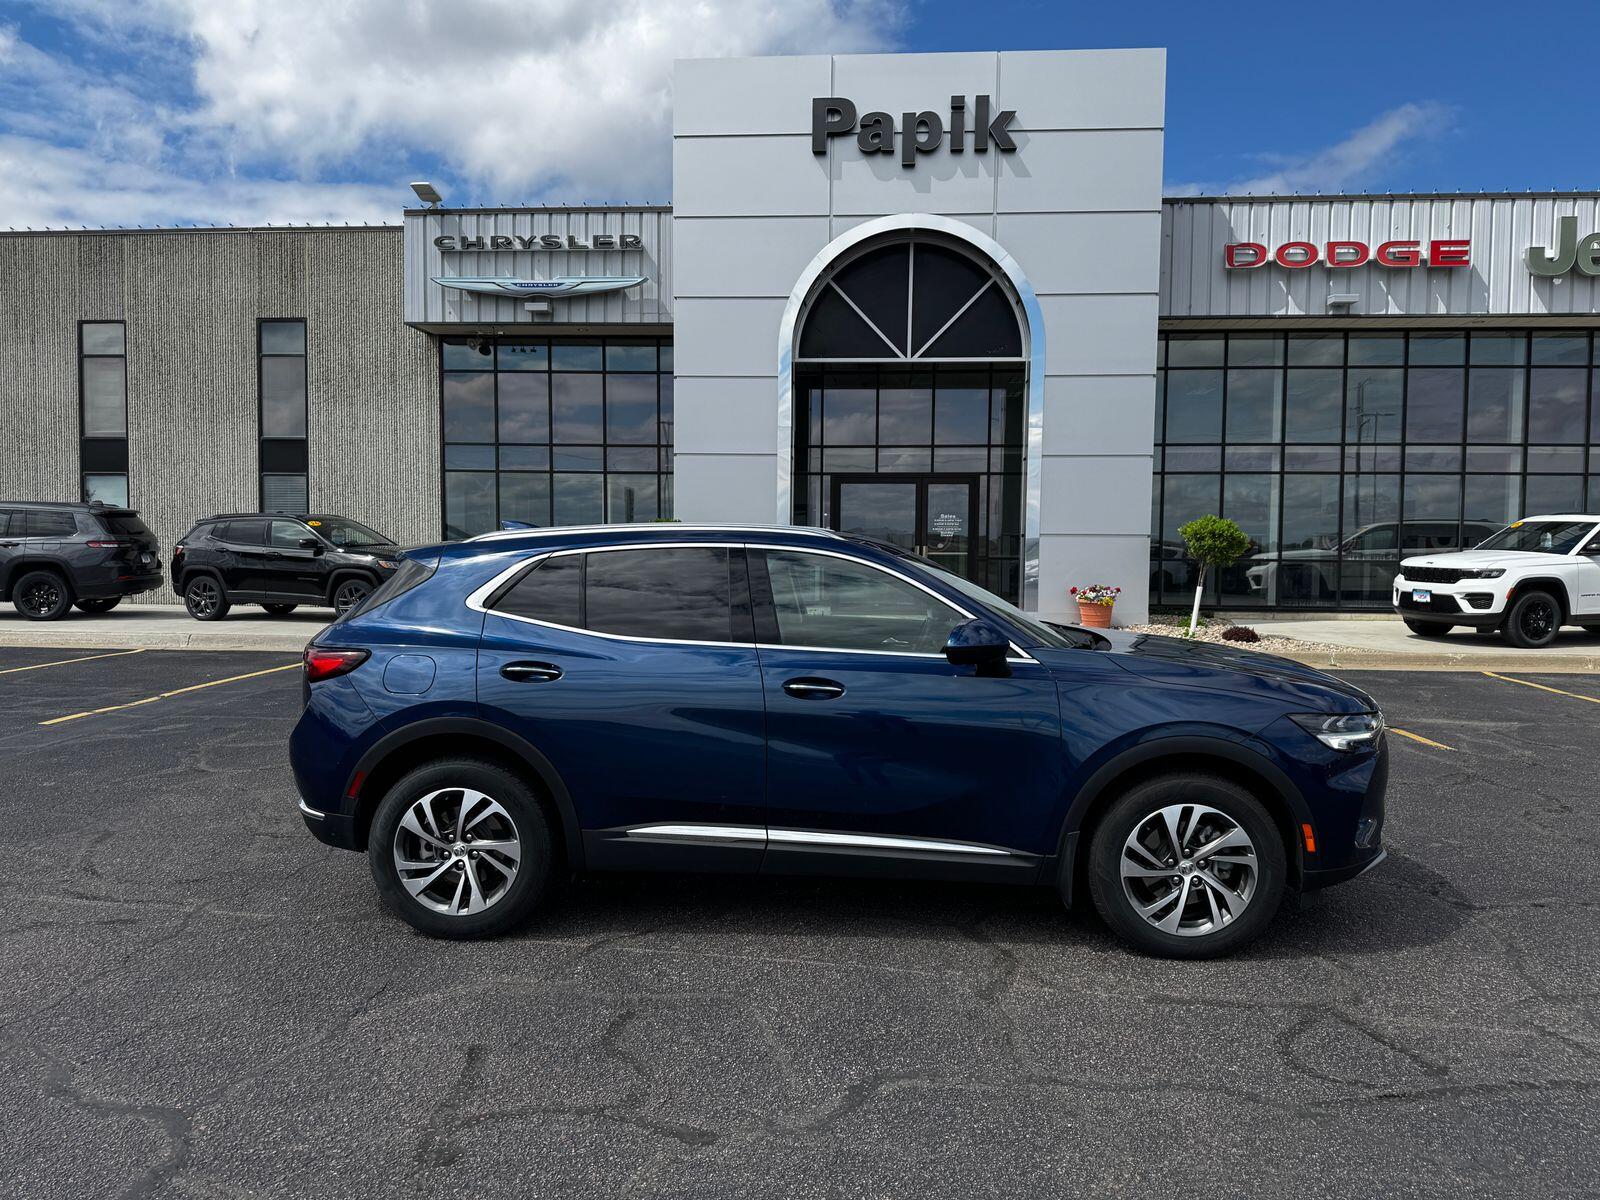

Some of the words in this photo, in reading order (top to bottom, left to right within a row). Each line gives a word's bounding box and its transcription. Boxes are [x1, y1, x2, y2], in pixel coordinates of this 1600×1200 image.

[812, 94, 1018, 168] Papik
[433, 234, 643, 250] CHRYSLER
[1225, 239, 1472, 268] DODGE
